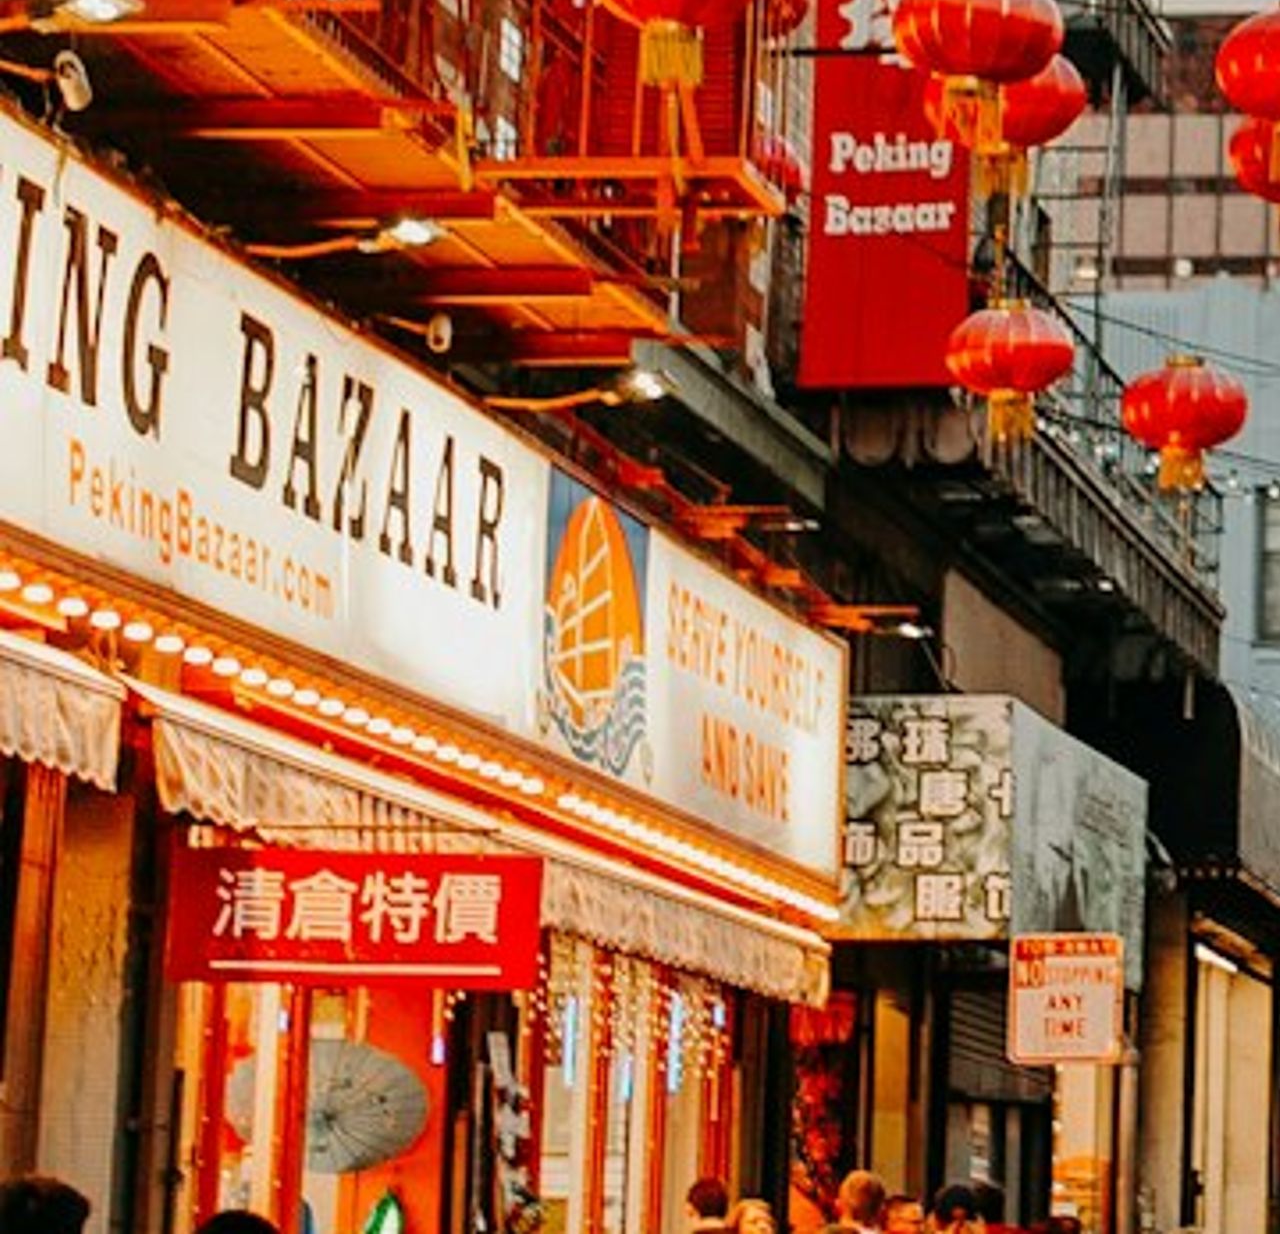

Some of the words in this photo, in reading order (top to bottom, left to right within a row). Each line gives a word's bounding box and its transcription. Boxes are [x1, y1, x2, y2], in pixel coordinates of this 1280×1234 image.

[831, 132, 954, 179] Peking
[824, 194, 956, 236] Bazaar
[229, 311, 506, 610] BAZAAR
[68, 437, 336, 620] PekingBazaar.com
[667, 577, 728, 687] SERVE
[702, 712, 740, 798] AND
[743, 732, 789, 824] SAVE
[212, 868, 502, 944] 清倉特價
[1043, 1017, 1086, 1040] TIME
[1045, 995, 1082, 1010] ANY
